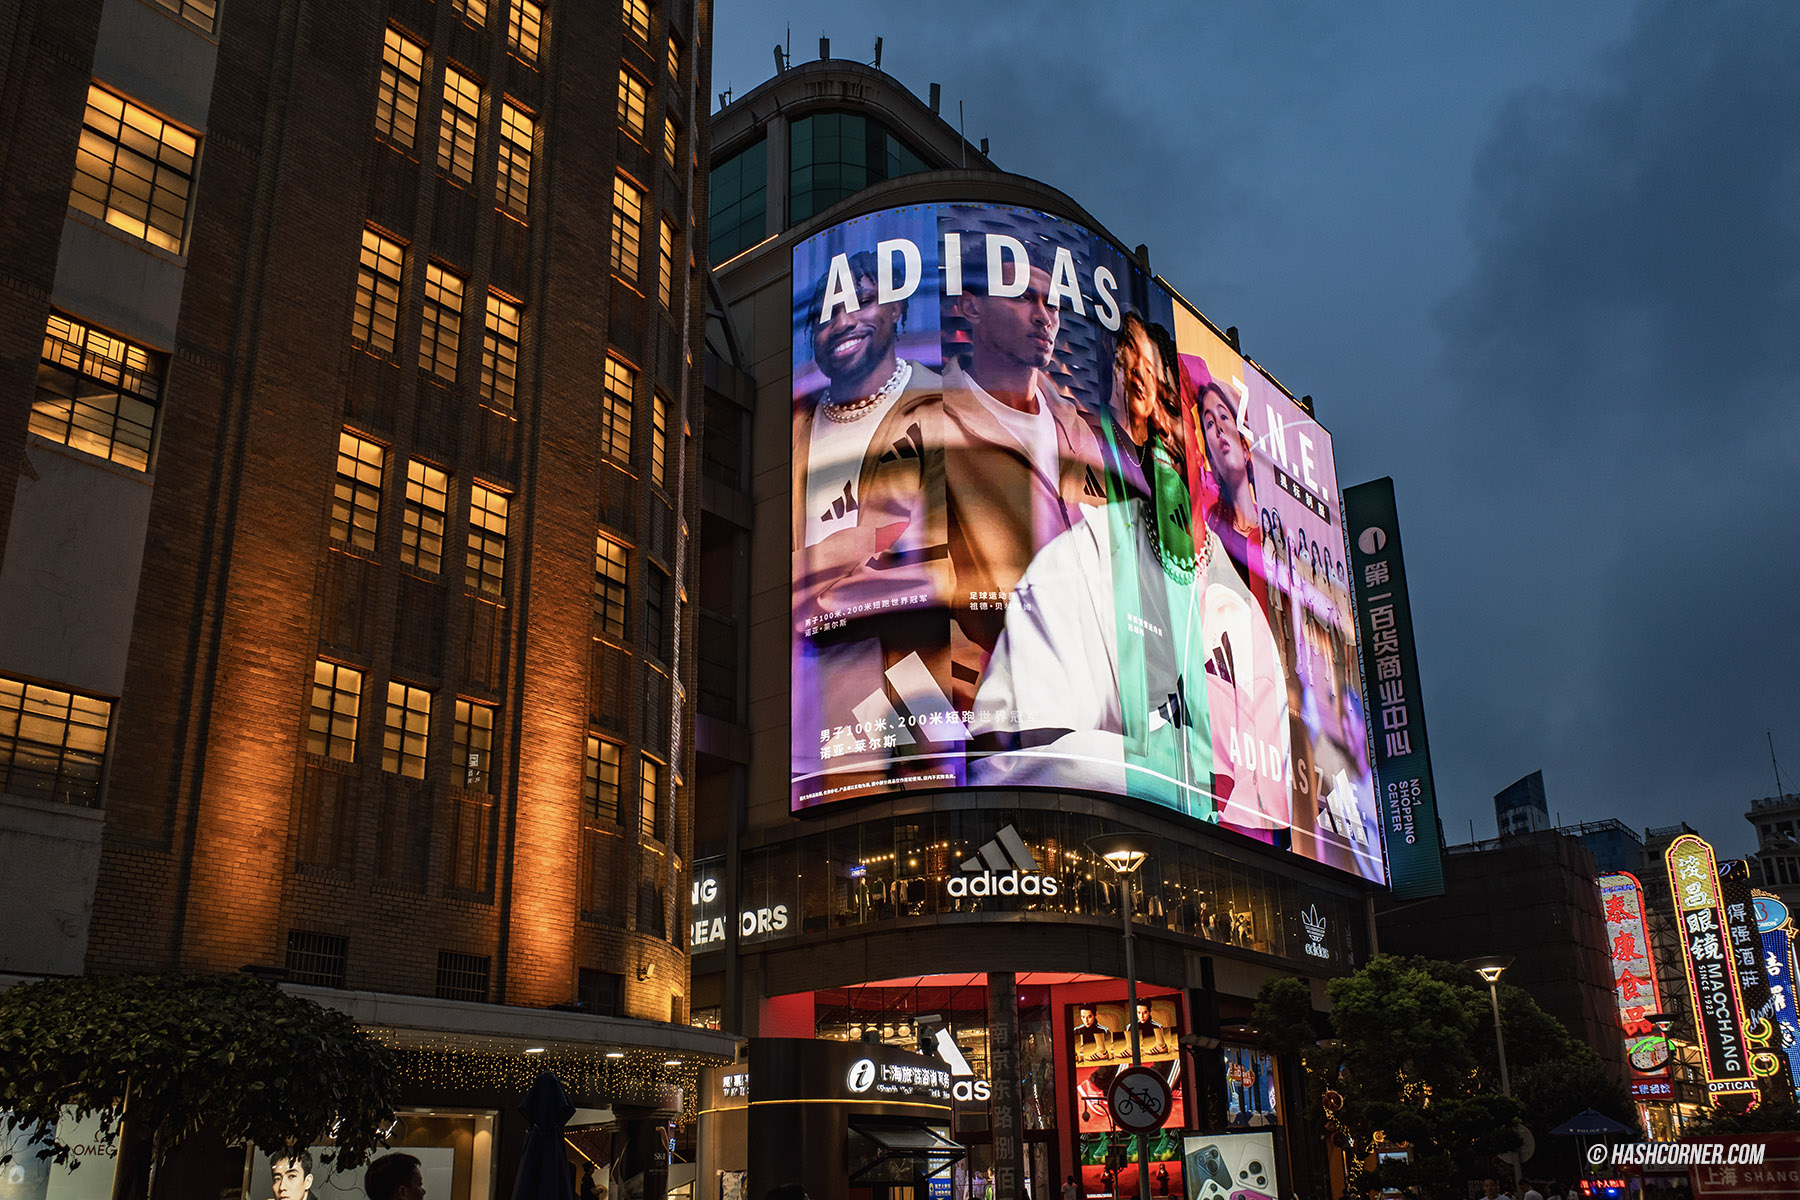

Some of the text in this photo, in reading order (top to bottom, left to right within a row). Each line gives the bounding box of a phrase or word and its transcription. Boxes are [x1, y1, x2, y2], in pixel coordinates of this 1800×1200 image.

[819, 232, 1121, 332] ADIDAS
[1232, 375, 1329, 501] Z.N.E.
[1364, 560, 1412, 759] 第一百货商业中心
[1230, 726, 1309, 795] ADIDAS
[1387, 783, 1403, 833] CENTER
[1399, 780, 1416, 845] SHOPPING
[1410, 778, 1422, 806] NO.1
[946, 869, 1058, 897] adidas
[1678, 855, 1724, 961] 茂昌眼镜
[691, 904, 788, 946] EAORS
[1304, 941, 1330, 959] adidas
[1604, 894, 1658, 1037] 泰康食品
[1698, 965, 1715, 1015] SINCE 1923
[1707, 963, 1740, 1072] MAOCHANG
[991, 1022, 1016, 1200] 南京东路捌佰
[1708, 1080, 1756, 1092] OPTICAL
[73, 1144, 118, 1156] OMEG
[1704, 1166, 1737, 1186] 上海
